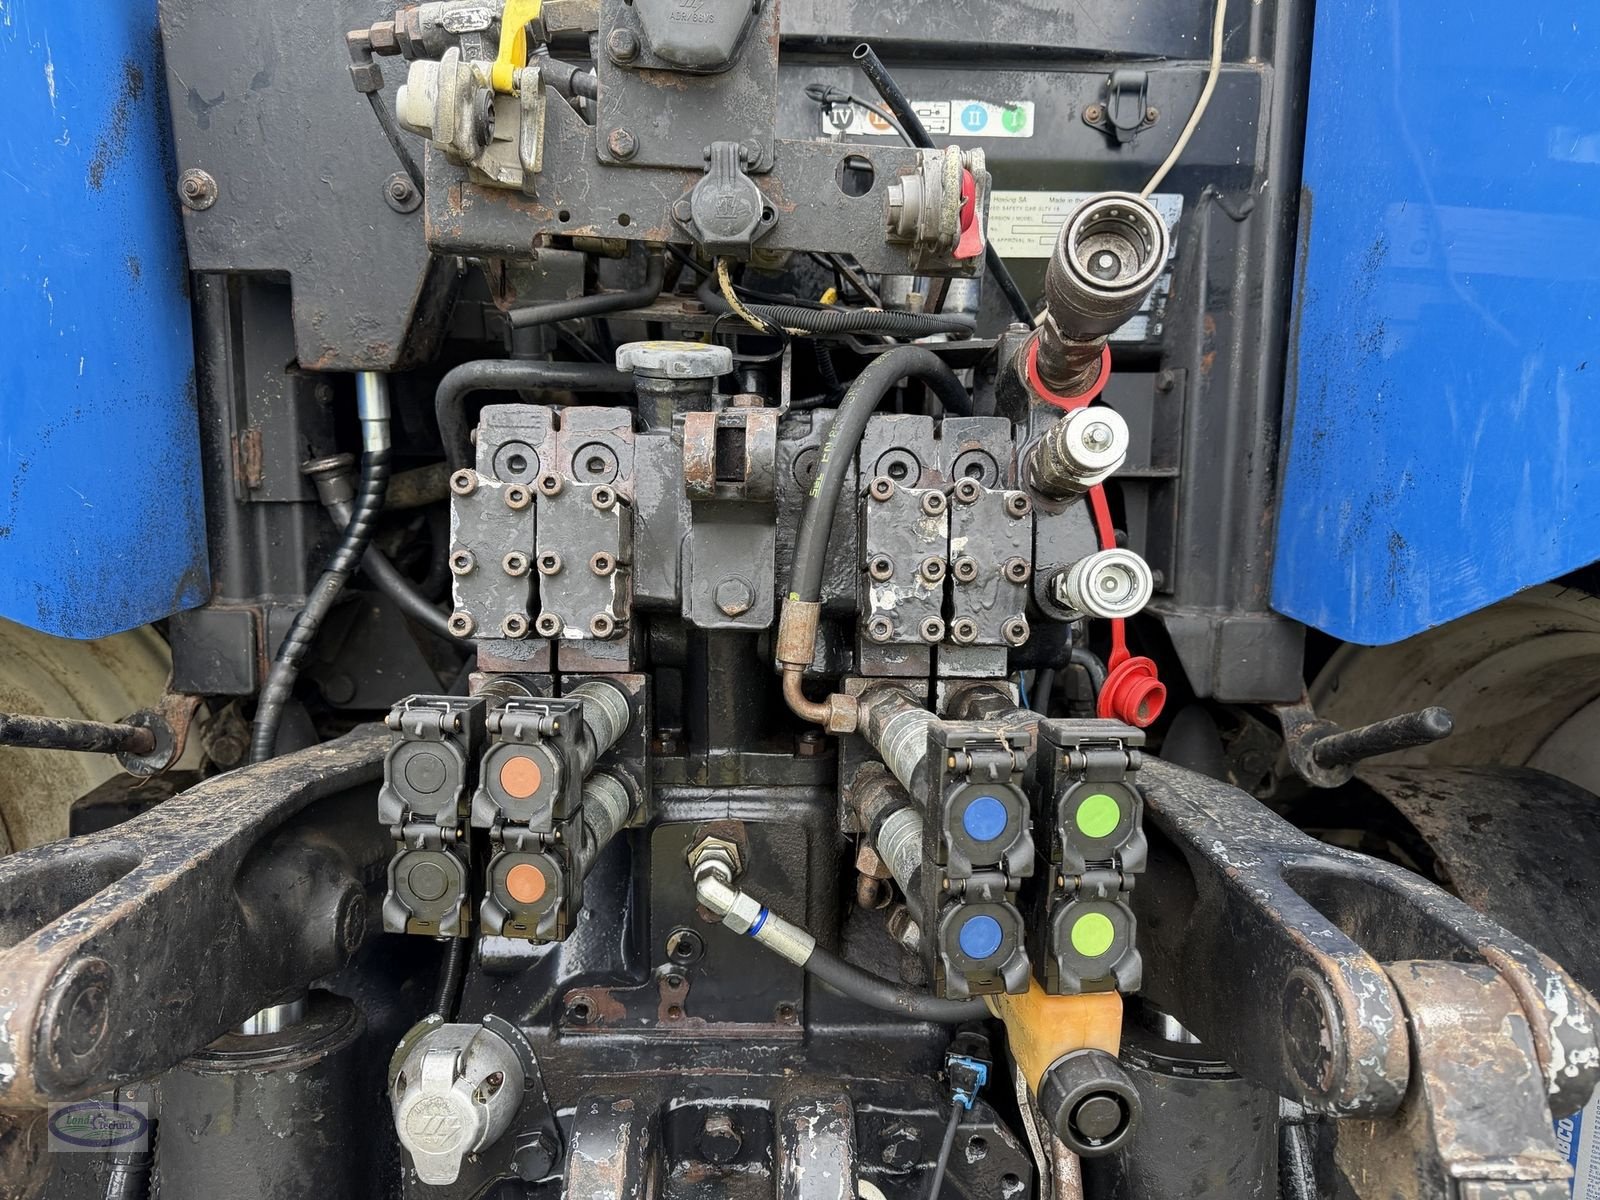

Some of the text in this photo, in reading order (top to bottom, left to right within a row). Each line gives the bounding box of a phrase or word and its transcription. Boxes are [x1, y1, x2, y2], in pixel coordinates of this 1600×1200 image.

[831, 108, 852, 125] IV
[968, 111, 981, 126] II
[1557, 1118, 1574, 1161] ABCO
